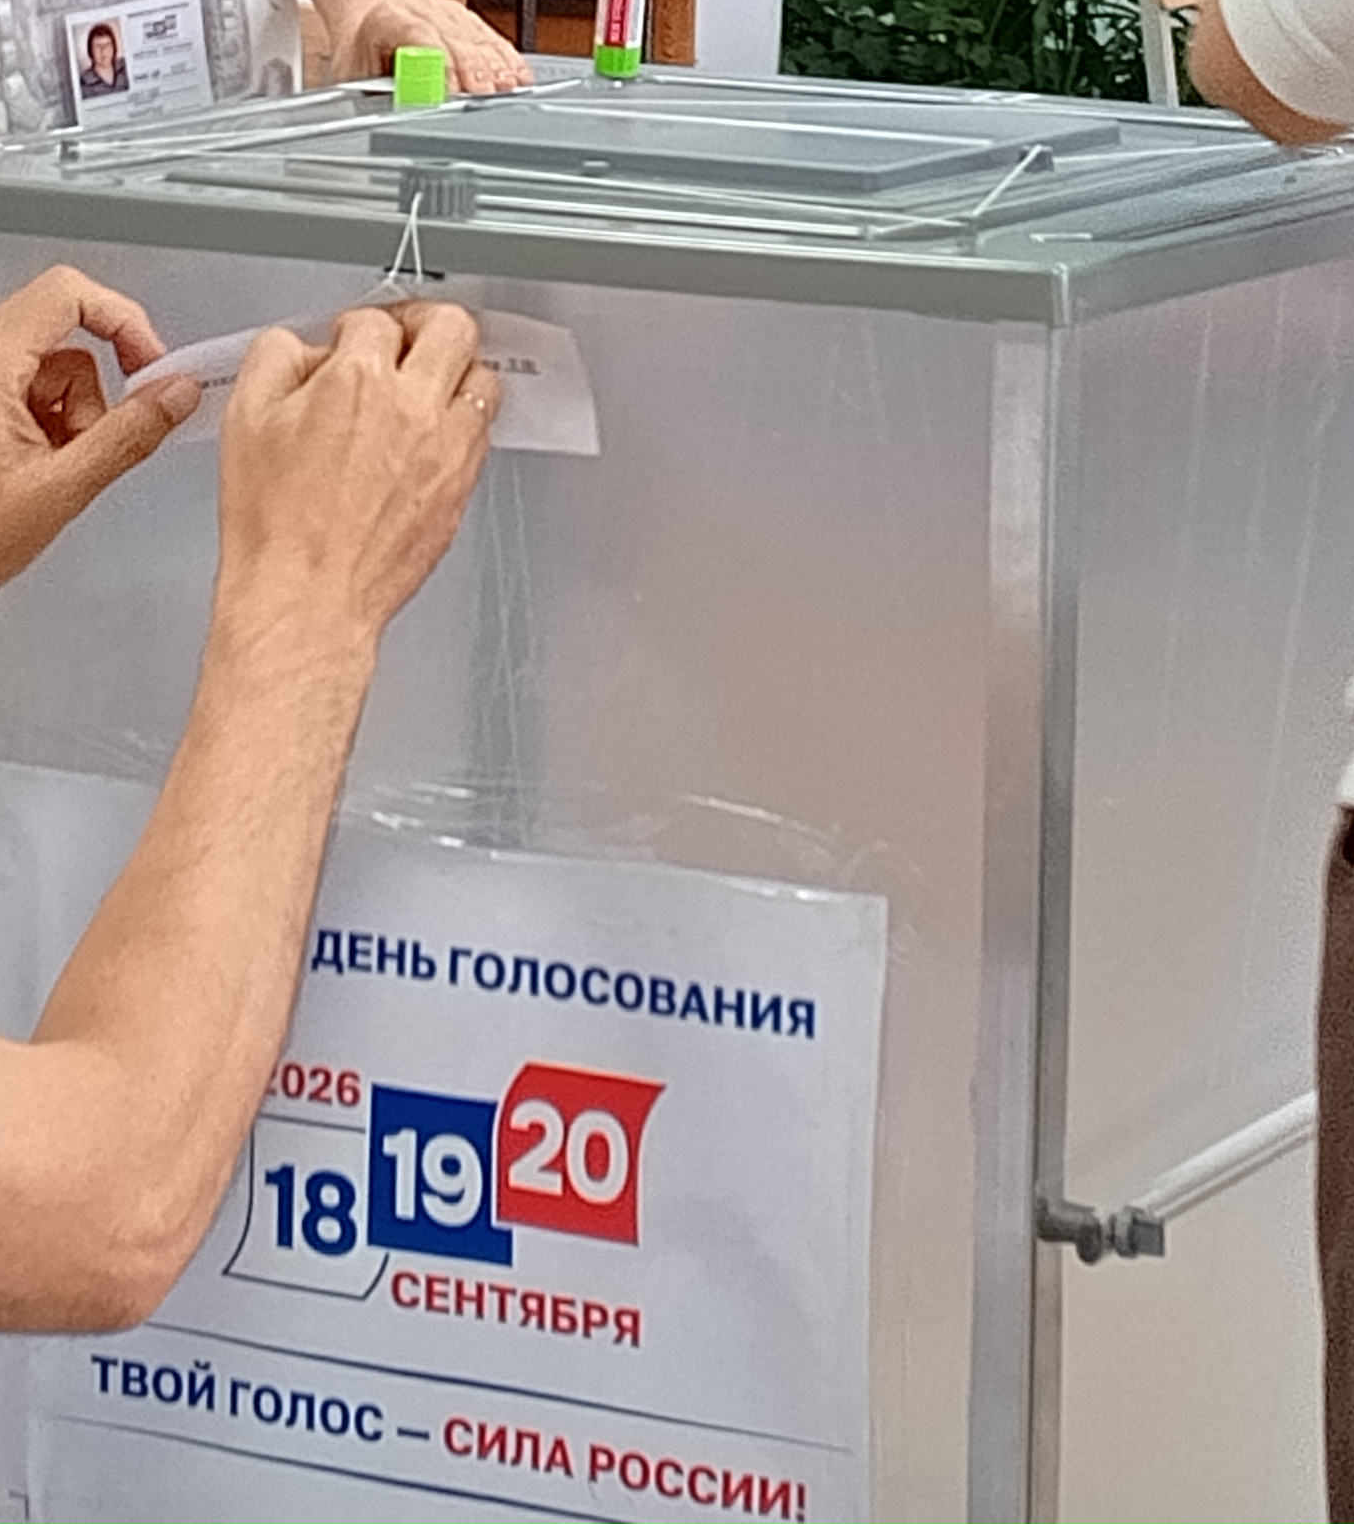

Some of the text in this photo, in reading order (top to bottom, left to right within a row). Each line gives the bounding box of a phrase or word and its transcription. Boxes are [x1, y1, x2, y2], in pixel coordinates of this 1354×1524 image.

[311, 929, 816, 1040] ДЕНЬ ГОЛОСОВАНИЯ
[265, 1100, 629, 1257] 18 19 20
[391, 1271, 642, 1347] СЕНТЯБРЯ
[91, 1356, 217, 1413] ТВОЙ
[228, 1380, 383, 1442] ГОЛОС
[444, 1418, 574, 1476] СИЛА
[587, 1449, 808, 1521] РОССИИ!
